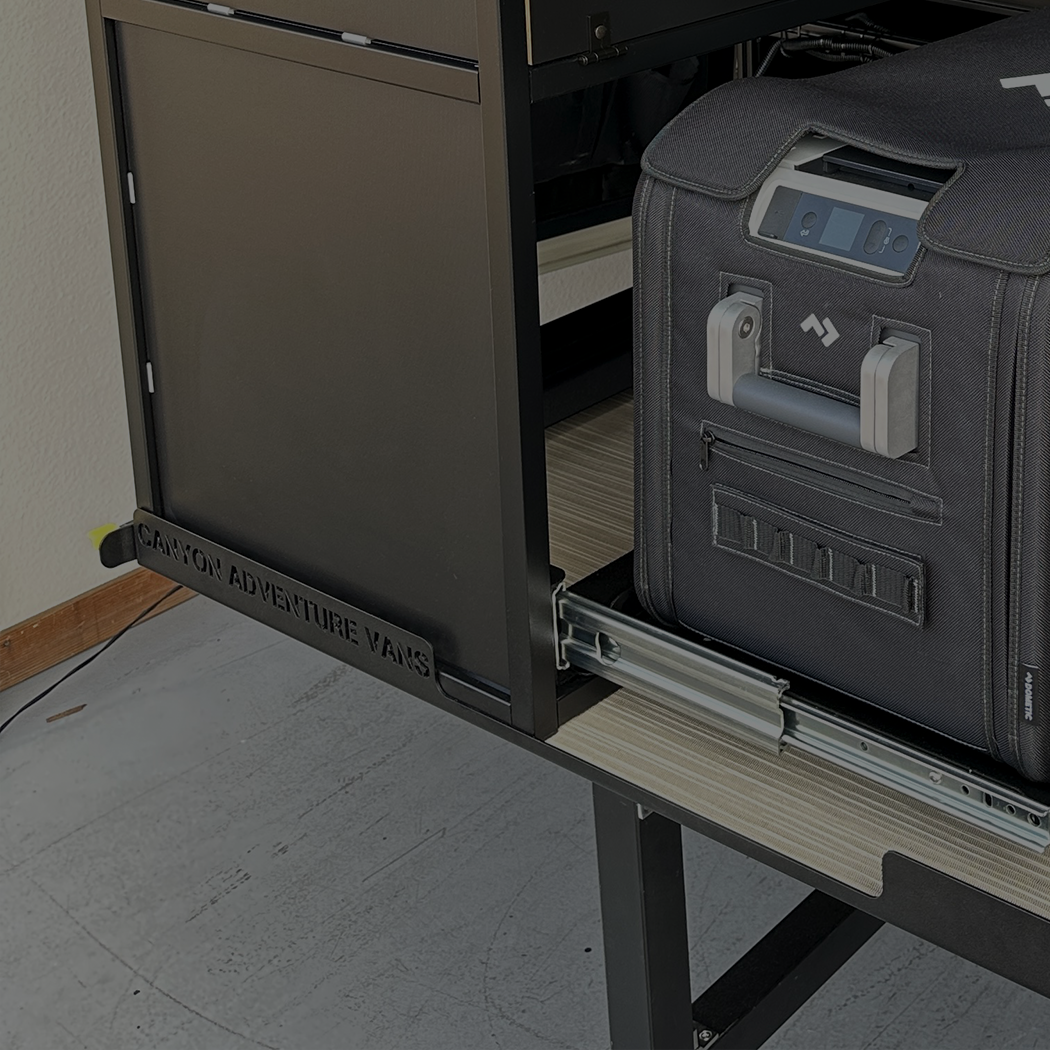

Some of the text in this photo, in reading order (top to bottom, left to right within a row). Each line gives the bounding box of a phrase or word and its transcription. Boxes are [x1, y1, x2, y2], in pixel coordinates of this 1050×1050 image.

[138, 522, 431, 678] CANYON ADVENTURE VANS
